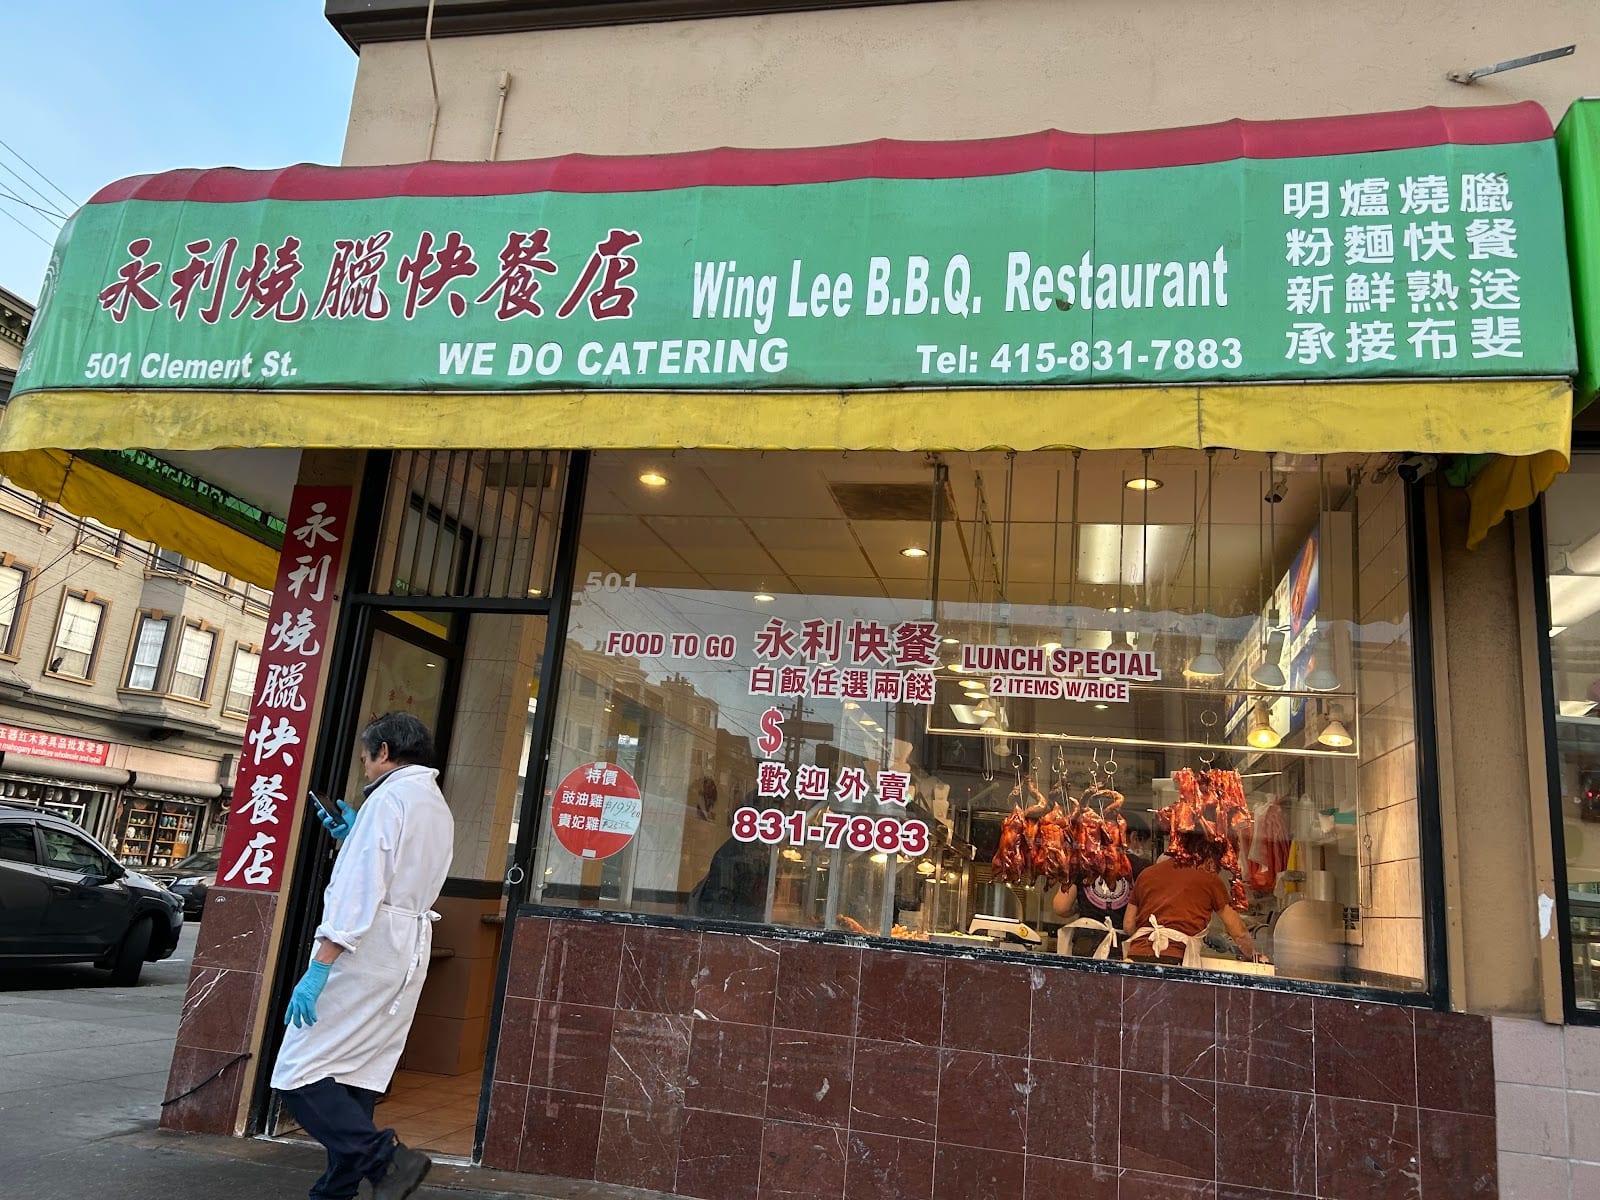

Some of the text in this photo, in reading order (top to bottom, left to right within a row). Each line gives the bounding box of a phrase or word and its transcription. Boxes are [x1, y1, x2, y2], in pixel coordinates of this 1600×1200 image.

[1282, 172, 1512, 220] 明爐燒臘
[1285, 218, 1518, 267] 粉麵快餐
[98, 229, 642, 325] 永利燒臘快餐店
[692, 245, 1229, 335] Wing Lee B.B.Q. Restaurant
[1286, 268, 1521, 315] 新鮮熟送
[438, 337, 789, 376] WE DO CATERING
[917, 338, 1243, 374] Tel: 415-831-7883
[1284, 316, 1524, 365] 承接布斐
[84, 350, 297, 379] 501 Clement St.
[585, 571, 637, 594] 501
[605, 630, 737, 662] FOOD TO GO
[755, 616, 941, 667] 永利快餐
[962, 643, 1161, 681] LUNCH SPECIAL
[223, 502, 339, 887] 永利燒臘快餐店
[749, 663, 936, 705] 白飯任選兩餸
[989, 676, 1129, 702] 2 ITEMS W/RICE
[757, 707, 785, 758] $
[585, 768, 619, 786] 特價
[757, 761, 911, 806] 歡迎外賣
[561, 790, 605, 809] 豉油雞
[557, 813, 600, 831] 貴妃雞
[732, 806, 929, 856] 831-7883
